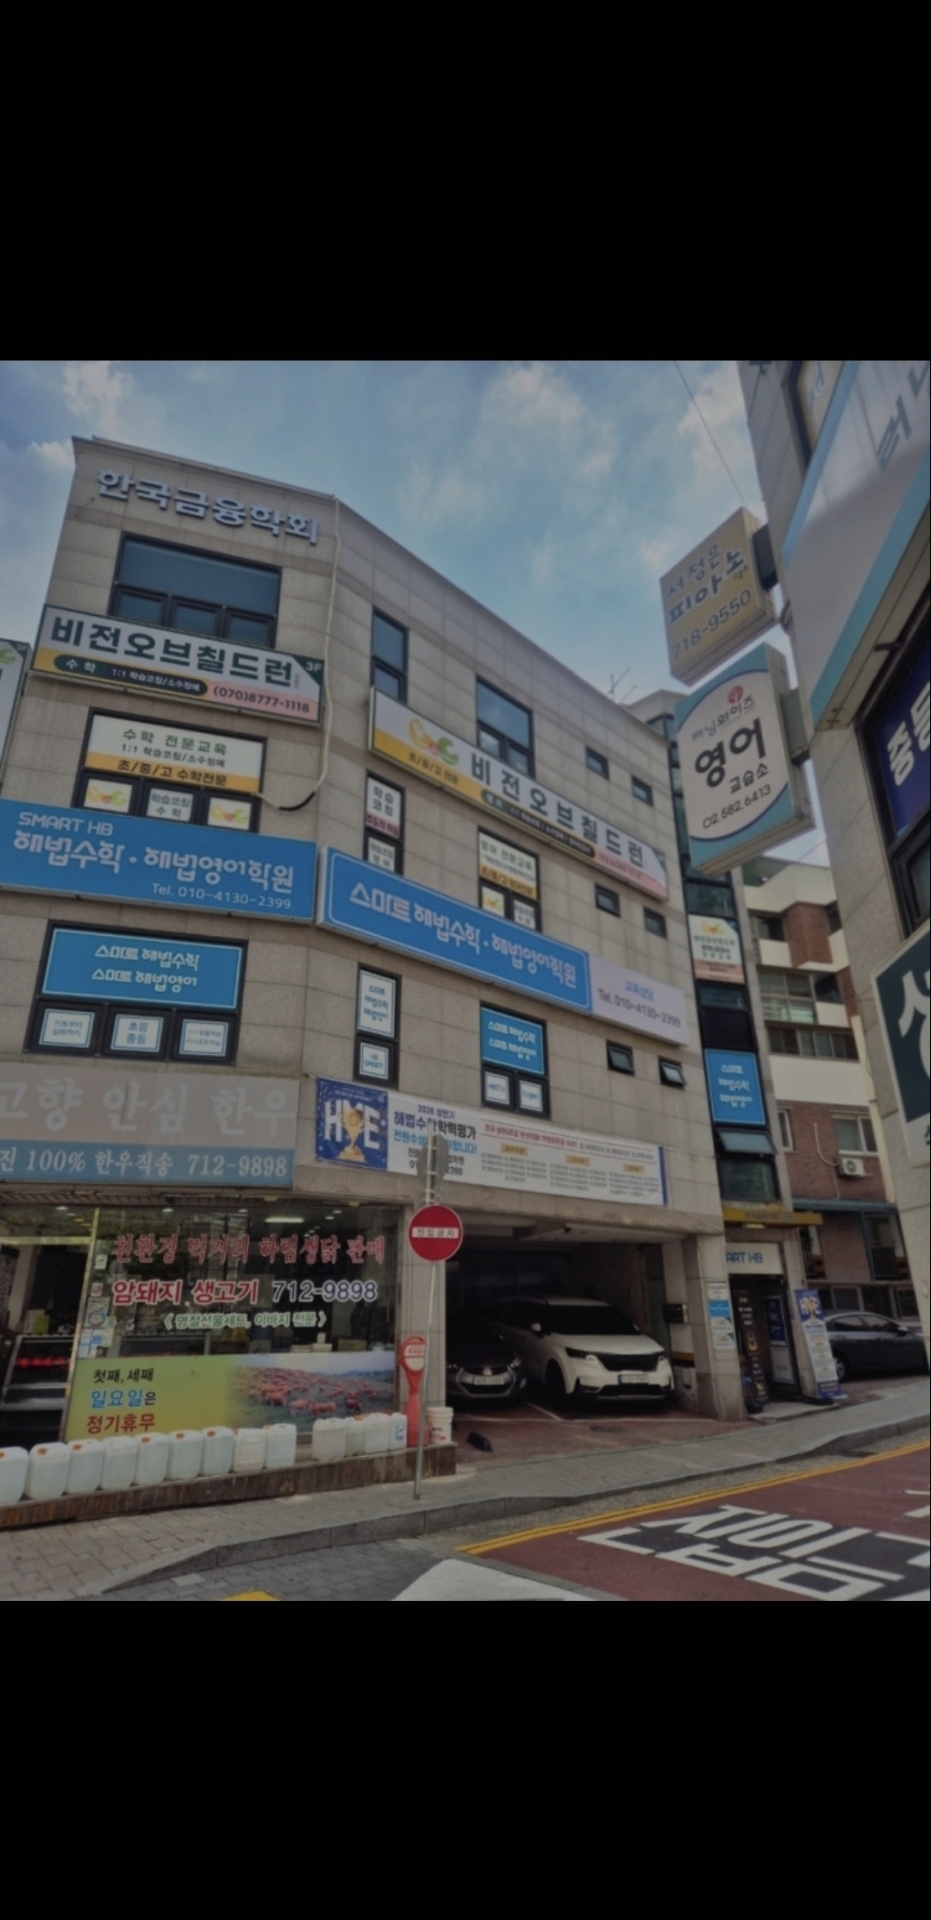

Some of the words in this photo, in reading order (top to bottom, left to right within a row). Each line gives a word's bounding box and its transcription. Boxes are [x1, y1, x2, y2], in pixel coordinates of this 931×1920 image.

[97, 469, 318, 546] 한국금융학회
[667, 544, 720, 598] 서정은
[668, 550, 745, 625] 피아노
[672, 589, 752, 660] 718-9550
[51, 617, 292, 691] 비전오브칠드런
[65, 658, 97, 673] 수학
[305, 661, 322, 673] 3F
[112, 668, 127, 678] 1:1
[213, 685, 311, 713] (070)8777-1118
[122, 743, 139, 754] 1:1
[165, 733, 228, 756] 전문교육
[695, 717, 766, 788] 영어
[118, 759, 173, 778] 초/중/고
[177, 768, 228, 787] 수학전문
[729, 763, 769, 795] 교습소
[18, 812, 81, 832] SMART
[88, 821, 114, 837] HB
[470, 751, 645, 869] 비전오브칠드런
[13, 830, 125, 874] 해법수학
[143, 846, 295, 895] 해법영어학원
[152, 882, 174, 896] Tel.
[178, 887, 292, 910] 010-4130-2399
[349, 881, 412, 925] 스마트
[413, 902, 481, 956] 해법수학
[490, 931, 578, 990] 해법영어학원
[95, 945, 139, 961] 스마트
[141, 949, 201, 972] 해법수학
[91, 968, 133, 984] 스마트
[135, 971, 198, 994] 해법영어
[614, 994, 681, 1028] 010-4130-2399
[0, 1077, 84, 1132] 고향
[103, 1075, 189, 1136] 안심
[211, 1086, 297, 1140] 한우
[26, 1149, 86, 1172] 100%
[95, 1149, 174, 1177] 한우직송
[187, 1155, 288, 1178] 712-9898
[112, 1235, 178, 1264] 친환경
[187, 1235, 251, 1265] 먹거리
[258, 1234, 341, 1266] 하림생닭
[346, 1234, 386, 1265] 판매
[112, 1278, 184, 1306] 암돼지
[190, 1278, 260, 1306] 생고기
[272, 1279, 378, 1304] 712-9898
[90, 1388, 157, 1409] 일요일은
[86, 1413, 156, 1435] 정기휴무
[577, 1503, 930, 1600] 진입금
